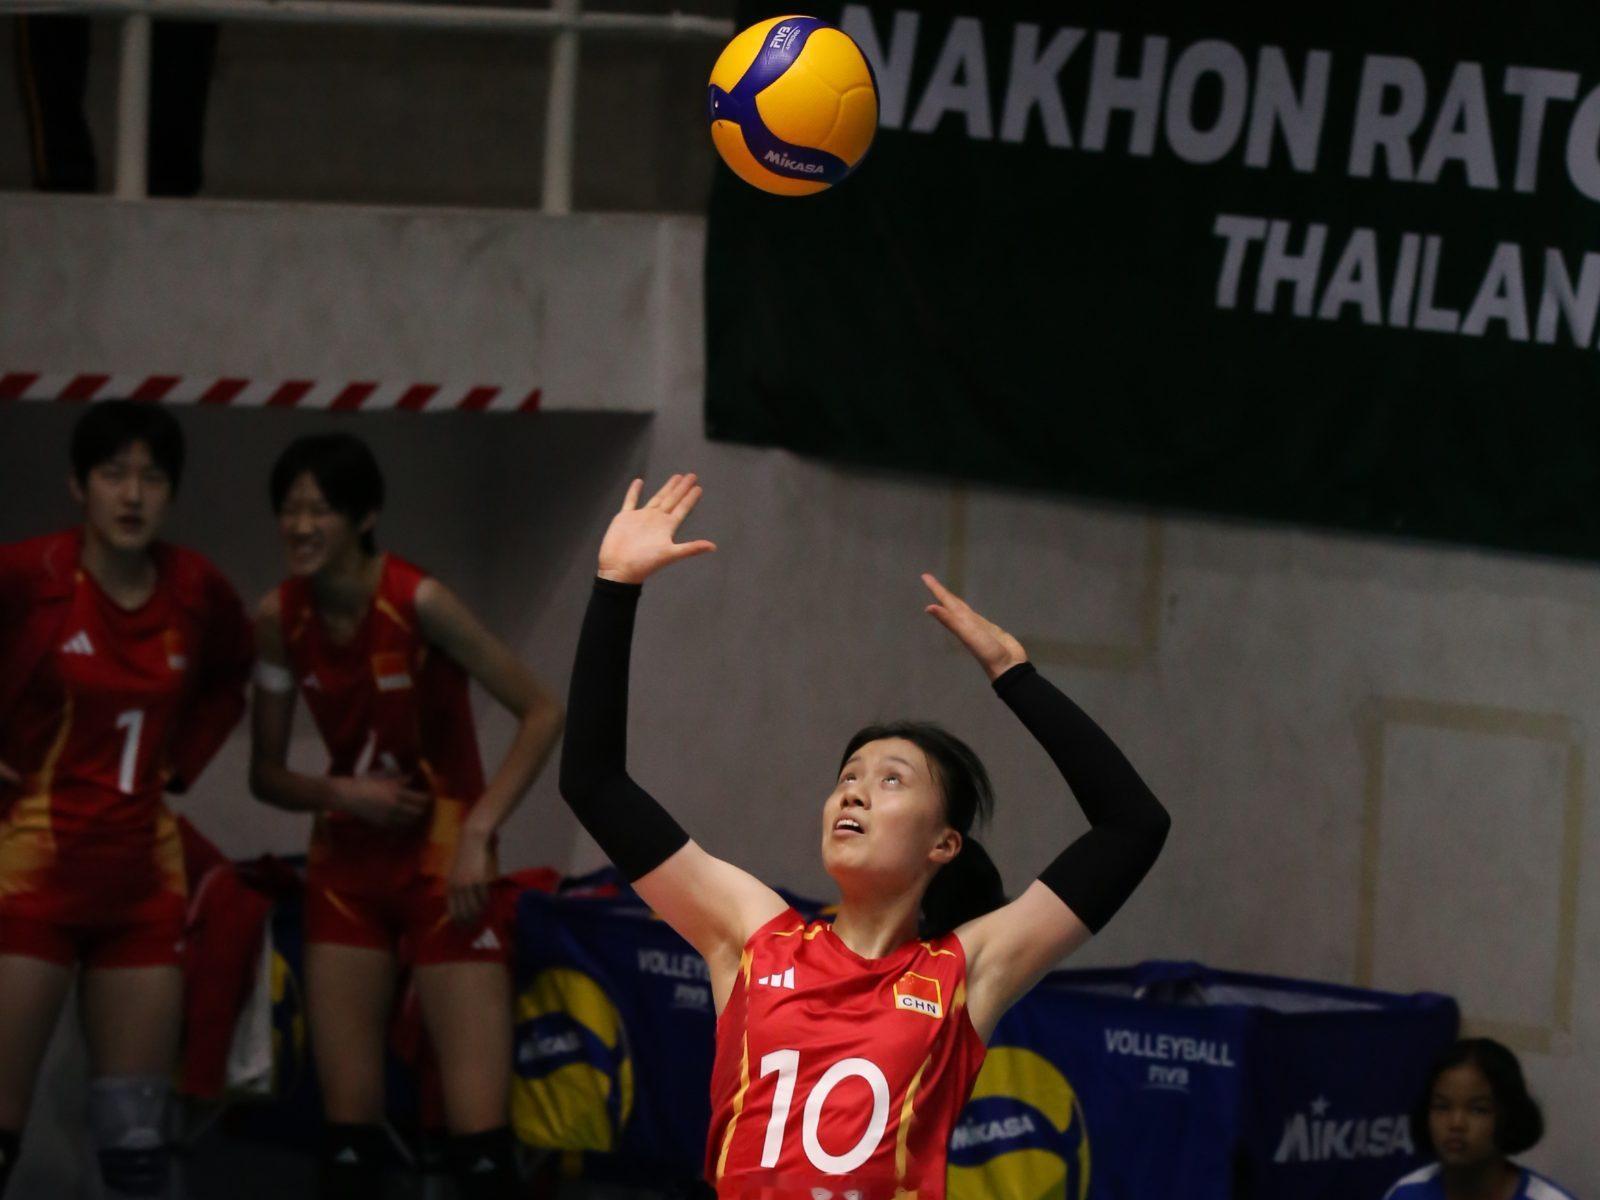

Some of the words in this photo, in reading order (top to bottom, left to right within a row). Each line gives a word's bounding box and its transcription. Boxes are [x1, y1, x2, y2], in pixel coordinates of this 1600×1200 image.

[770, 26, 791, 48] FIVB
[840, 4, 1333, 173] NAKHON
[1212, 213, 1600, 350] THAILAN
[116, 709, 145, 795] 1
[638, 948, 711, 982] VOLLEY
[902, 997, 936, 1014] CHN
[1104, 1028, 1235, 1067] VOLLEYBALL
[1147, 1065, 1189, 1085] FIVB
[760, 1049, 890, 1175] 10
